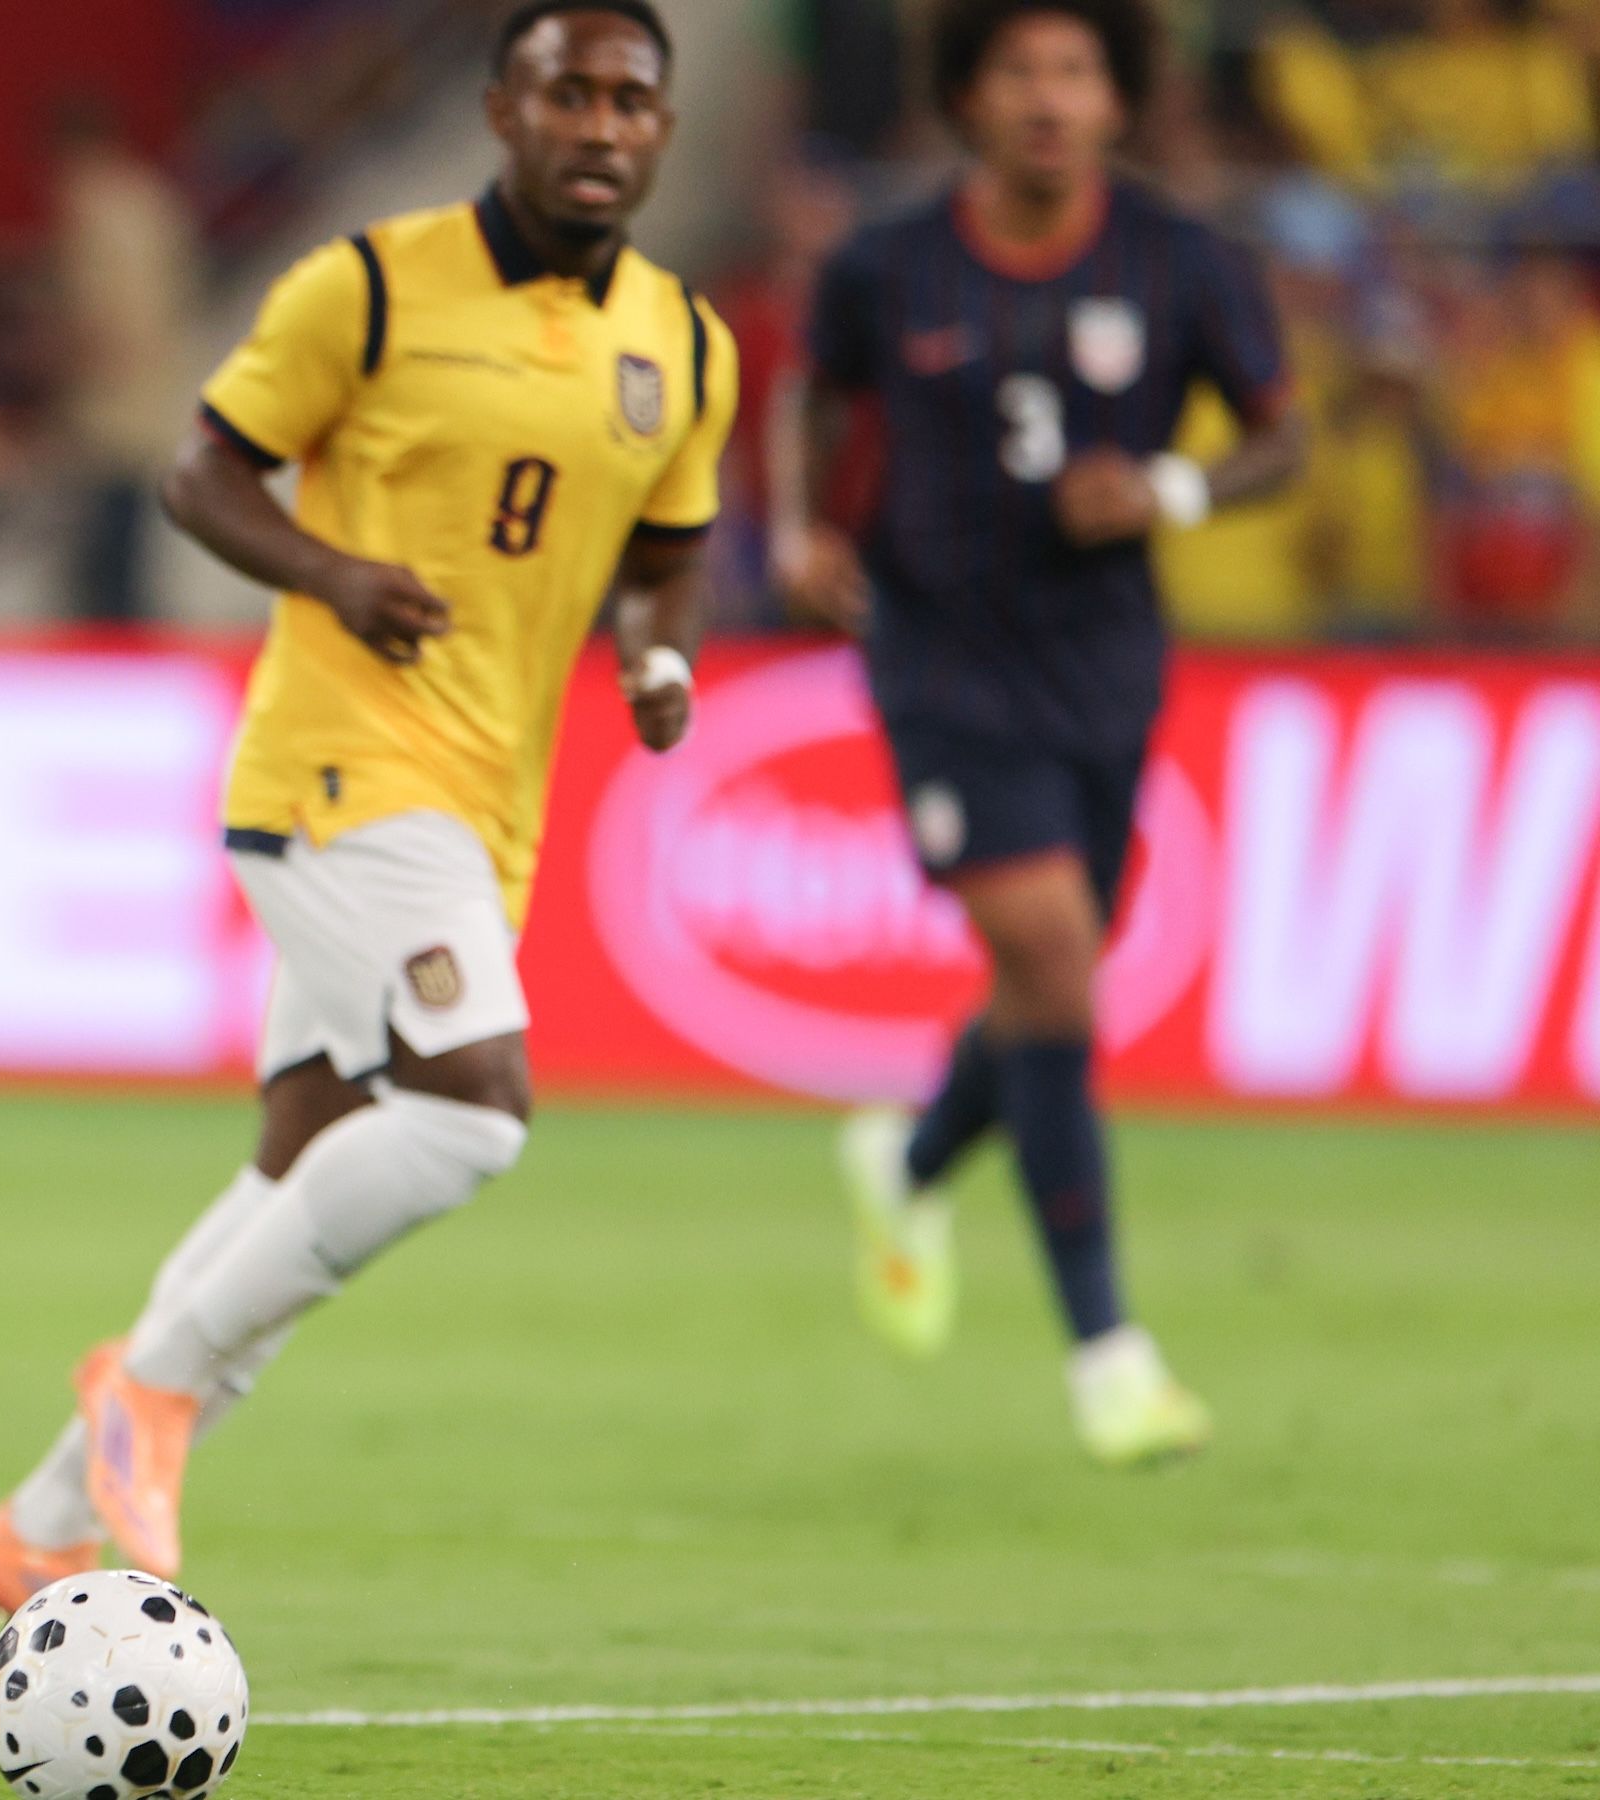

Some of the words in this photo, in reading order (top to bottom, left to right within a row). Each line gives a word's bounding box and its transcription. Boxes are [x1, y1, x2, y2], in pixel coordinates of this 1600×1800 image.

[997, 374, 1065, 482] 3
[489, 456, 558, 556] 9
[1210, 678, 1600, 1096] W
